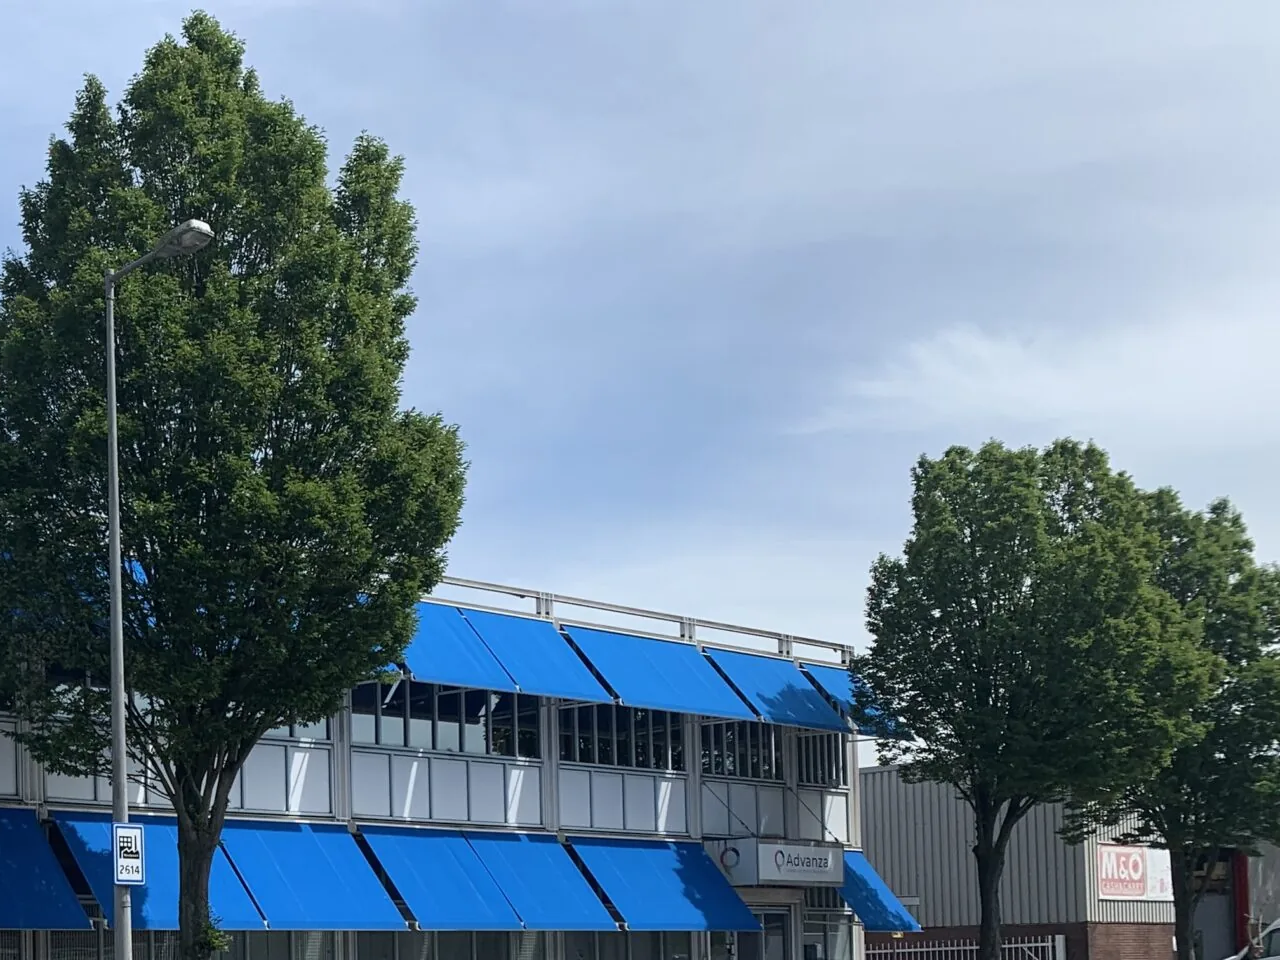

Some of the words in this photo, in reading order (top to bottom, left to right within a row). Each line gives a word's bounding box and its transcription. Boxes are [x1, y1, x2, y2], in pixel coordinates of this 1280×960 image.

[786, 852, 829, 868] Advanza
[1102, 852, 1143, 880] M&O
[119, 864, 140, 875] 2614
